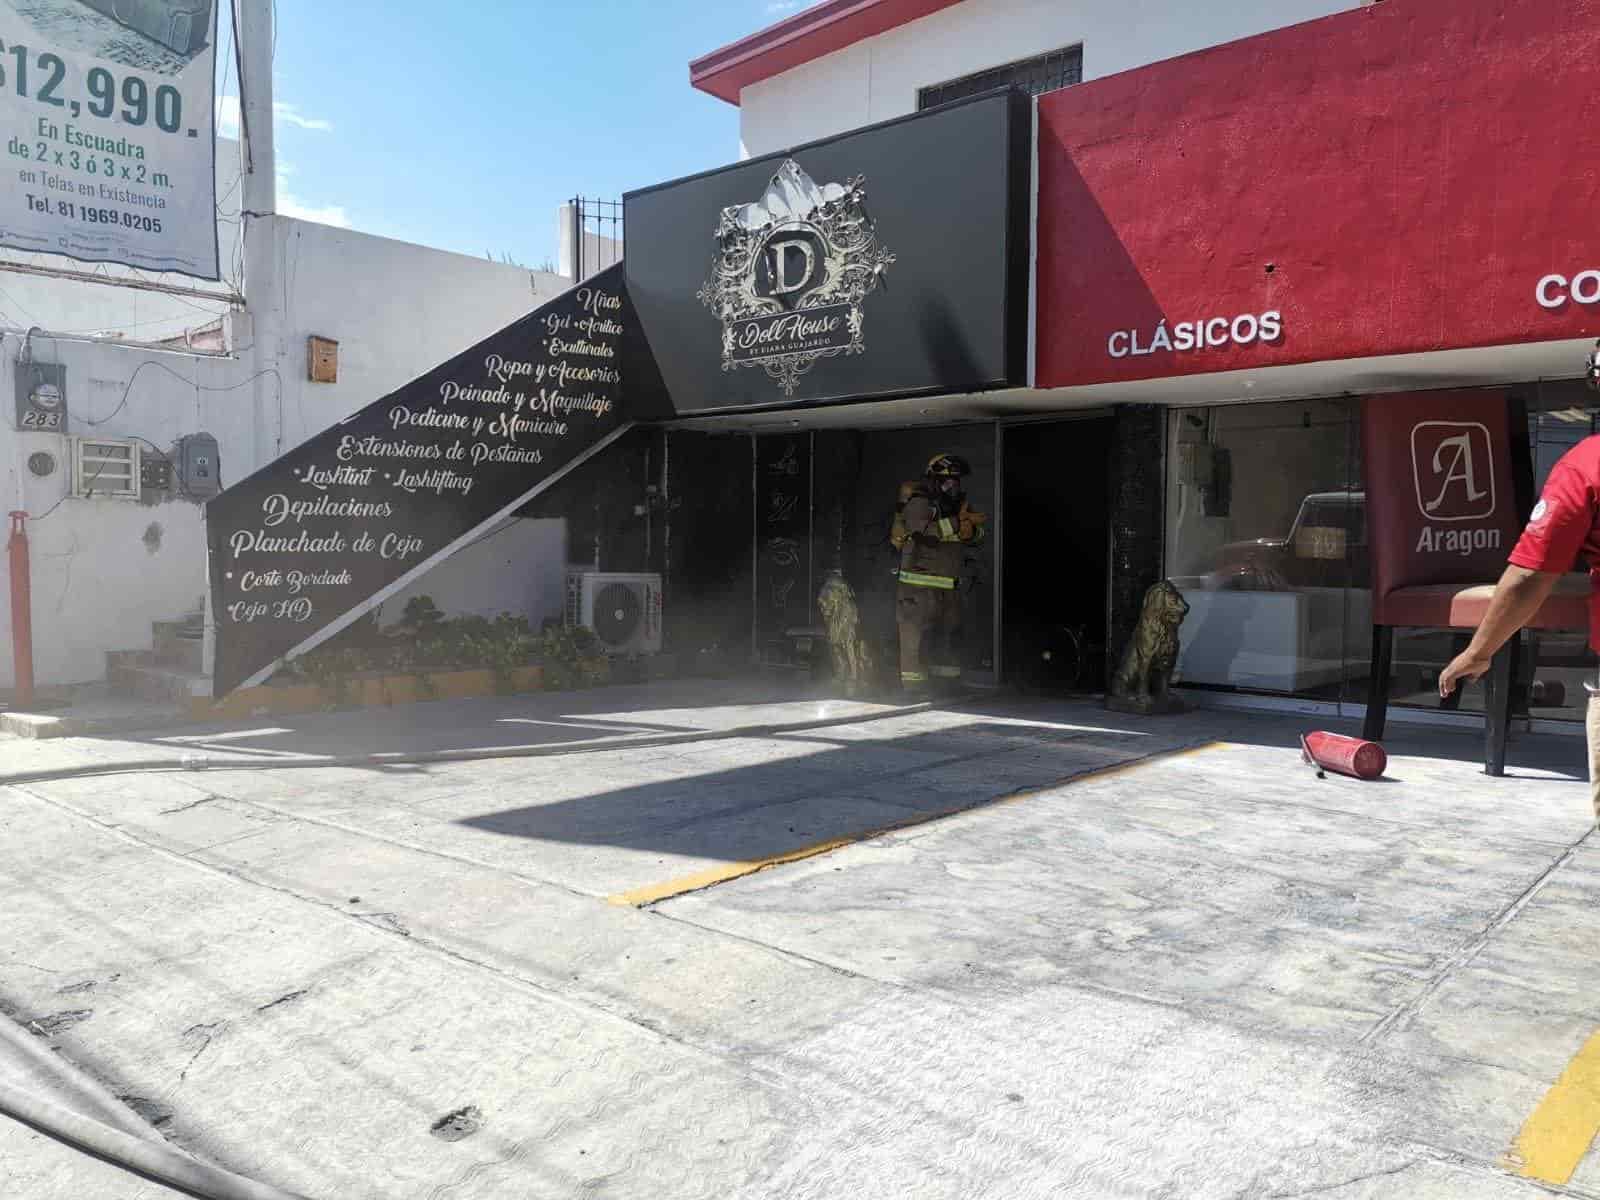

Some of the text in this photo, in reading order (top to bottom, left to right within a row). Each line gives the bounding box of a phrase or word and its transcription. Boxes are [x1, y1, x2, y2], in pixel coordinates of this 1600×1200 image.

[38, 117, 145, 160] En Escuadra
[8, 136, 174, 189] de 2 x 3 ó 3 x 2 m.
[19, 168, 166, 209] en Telas en Existencia
[25, 193, 162, 233] Tel. 81 1969.0205
[576, 288, 622, 316] Uñas
[1108, 269, 1600, 359] CLÁSICOS CO
[485, 354, 533, 383] Ropa
[535, 366, 549, 383] y
[440, 381, 613, 418] Peinado y Maquillaje
[24, 411, 60, 427] 283
[389, 405, 569, 441] Pedicure y Manicure
[336, 434, 543, 467] Extensiones de Pestañas
[301, 464, 474, 496] Lashtint Lashlifting
[1428, 431, 1487, 511] A
[262, 493, 393, 526] Depilaciones
[229, 529, 424, 560] Planchado de Ceja
[1416, 526, 1500, 556] Aragon
[241, 569, 352, 594] Corte Bordado
